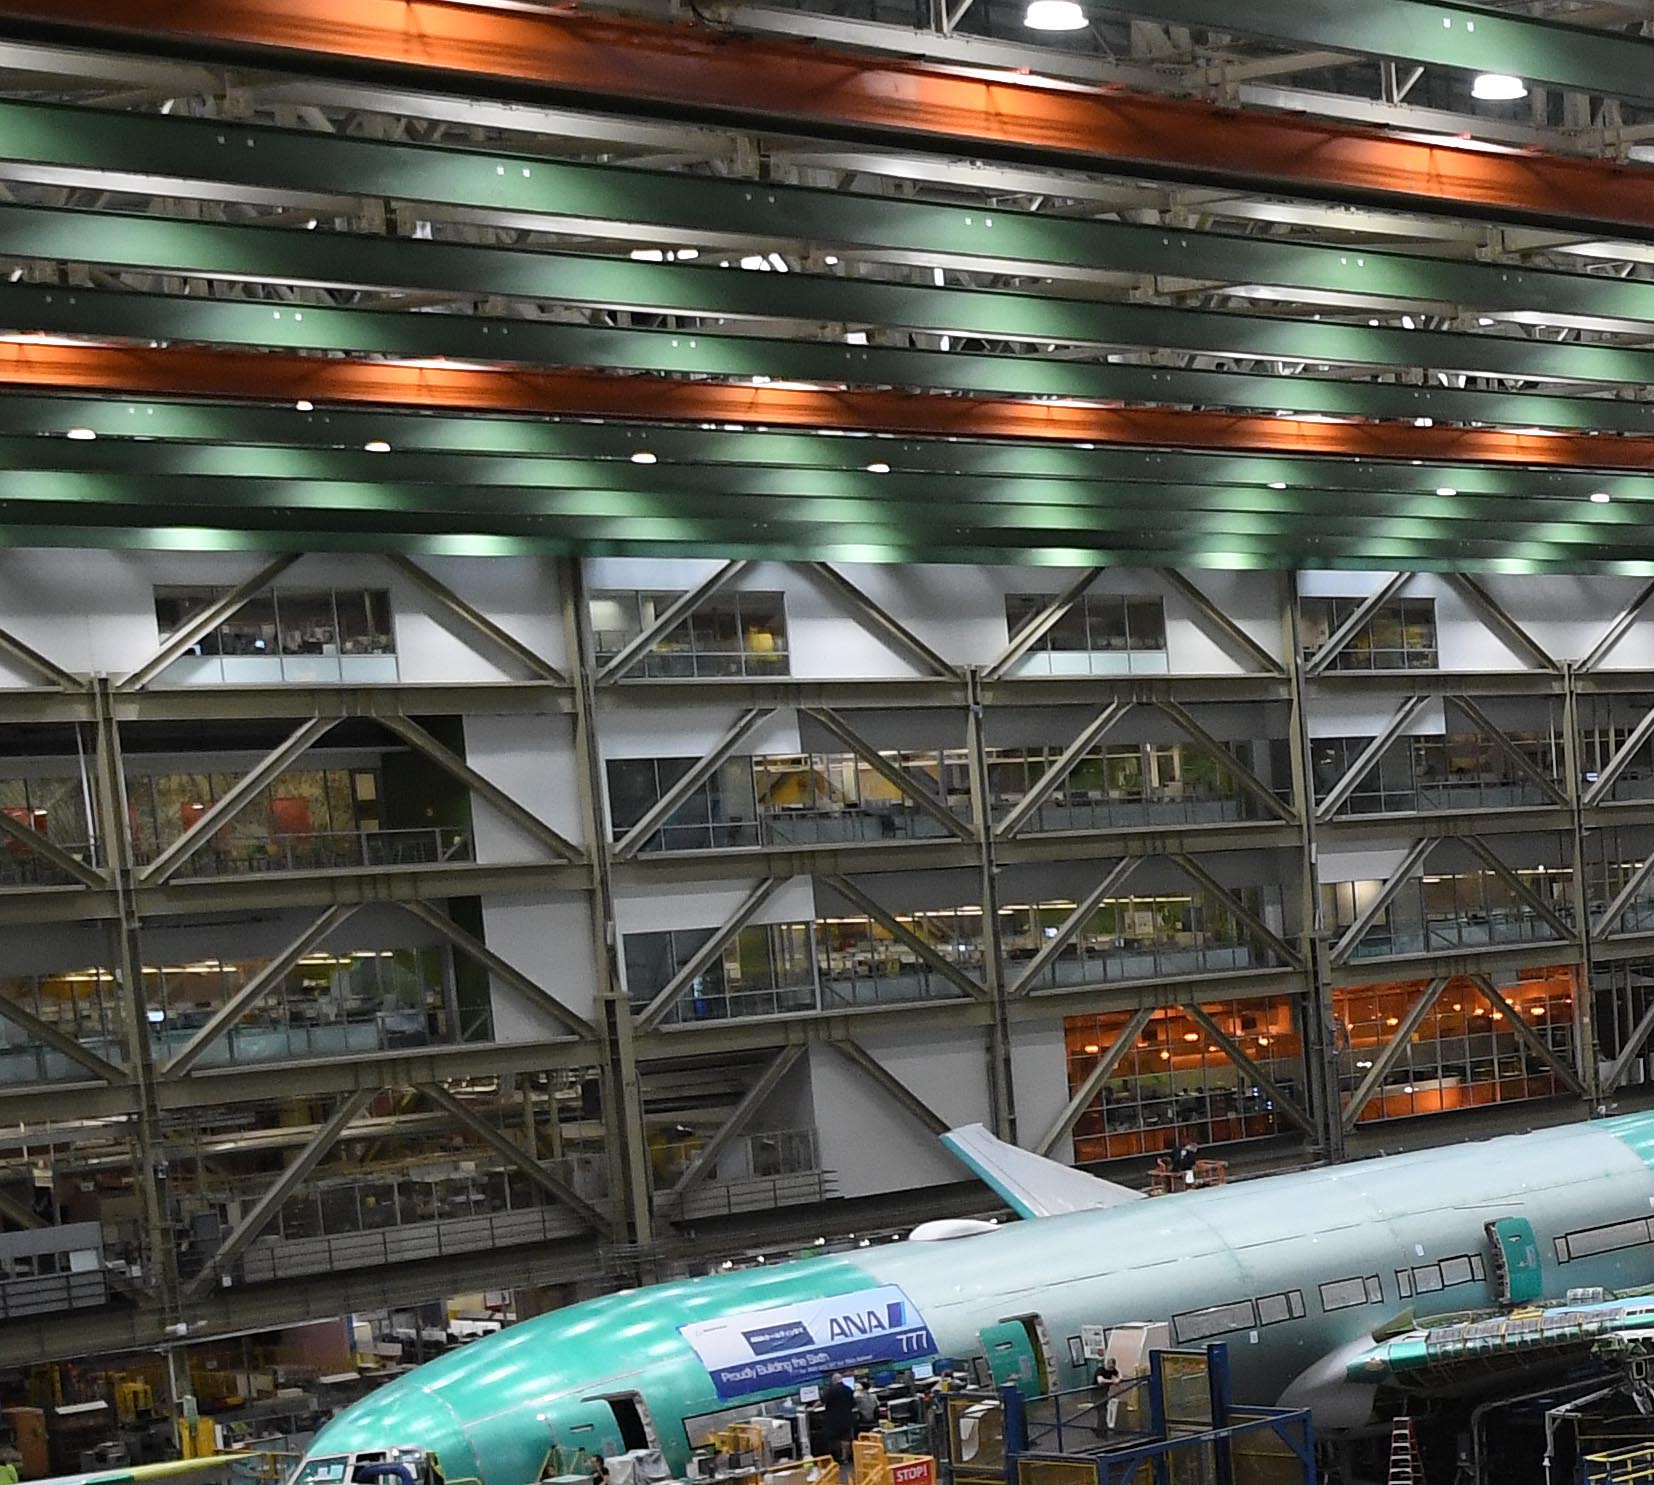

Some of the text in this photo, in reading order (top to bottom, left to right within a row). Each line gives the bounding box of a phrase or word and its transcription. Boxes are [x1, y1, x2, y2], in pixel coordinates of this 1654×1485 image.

[828, 1310, 888, 1341] ANA
[896, 1330, 928, 1353] 777
[720, 1368, 756, 1383] Proudly
[756, 1359, 792, 1374] Building
[791, 1356, 807, 1367] the
[896, 1463, 928, 1482] STOP!
